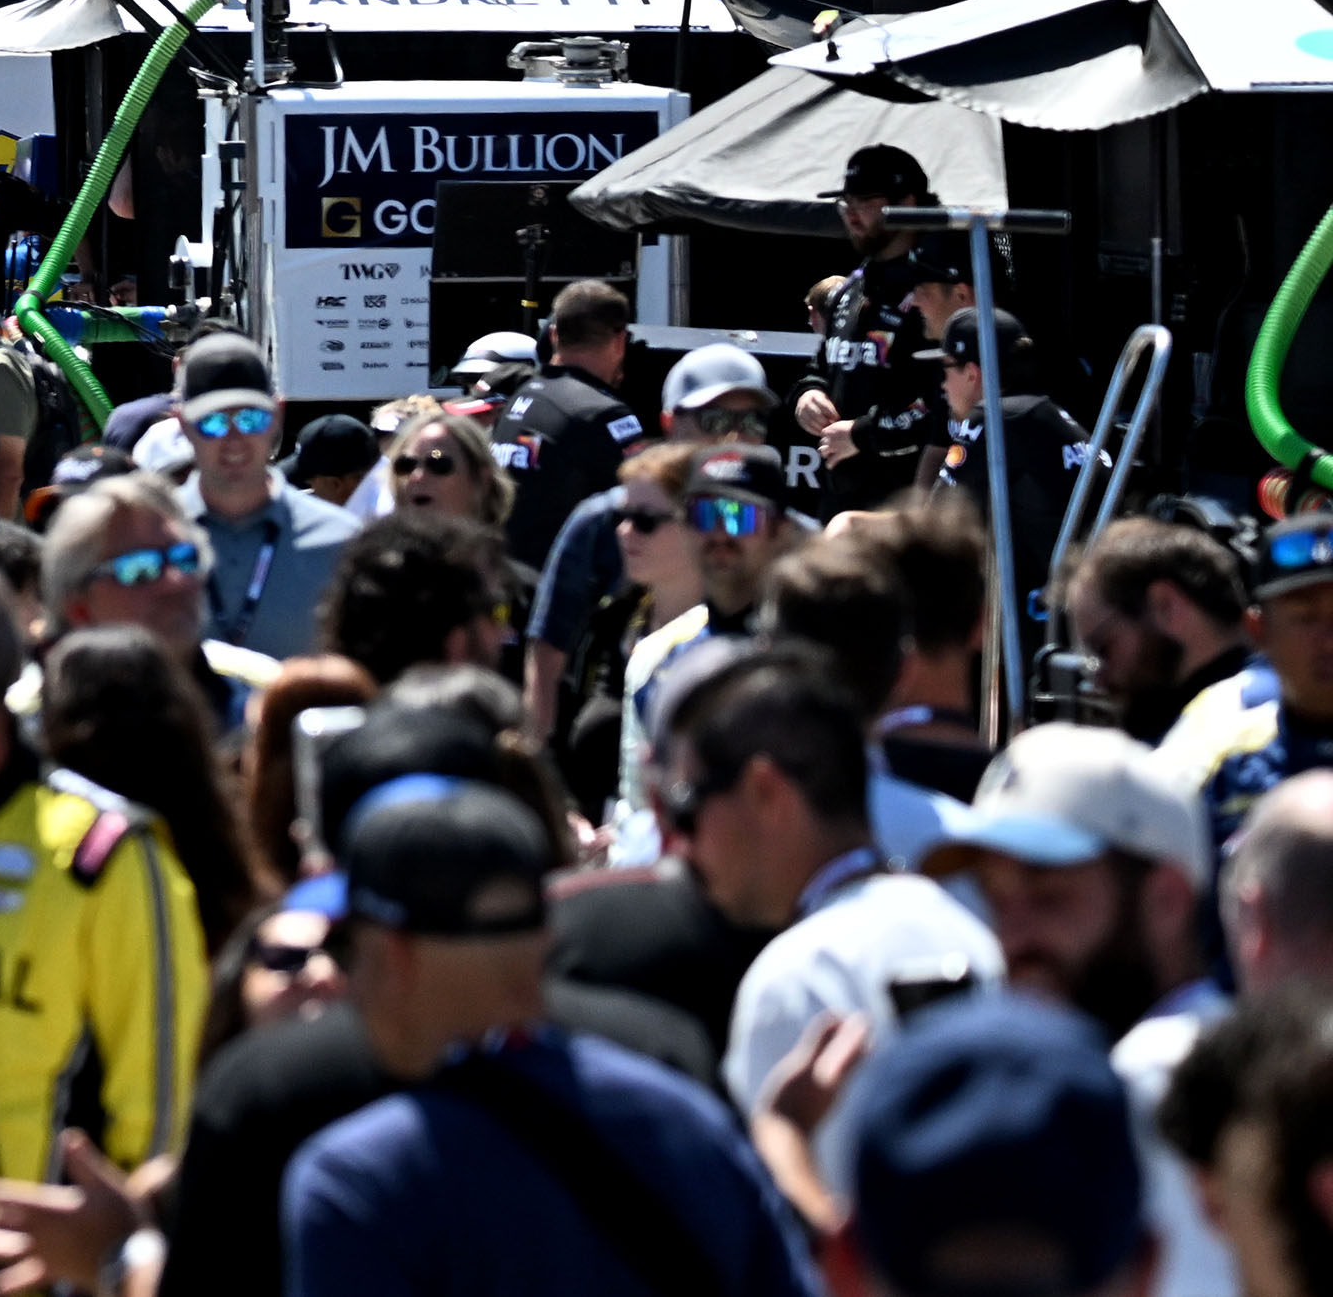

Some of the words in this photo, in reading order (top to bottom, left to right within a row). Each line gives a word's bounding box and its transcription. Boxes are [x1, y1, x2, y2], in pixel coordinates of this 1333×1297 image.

[317, 126, 397, 188] JM
[408, 126, 626, 172] BULLION
[339, 264, 384, 280] TWG
